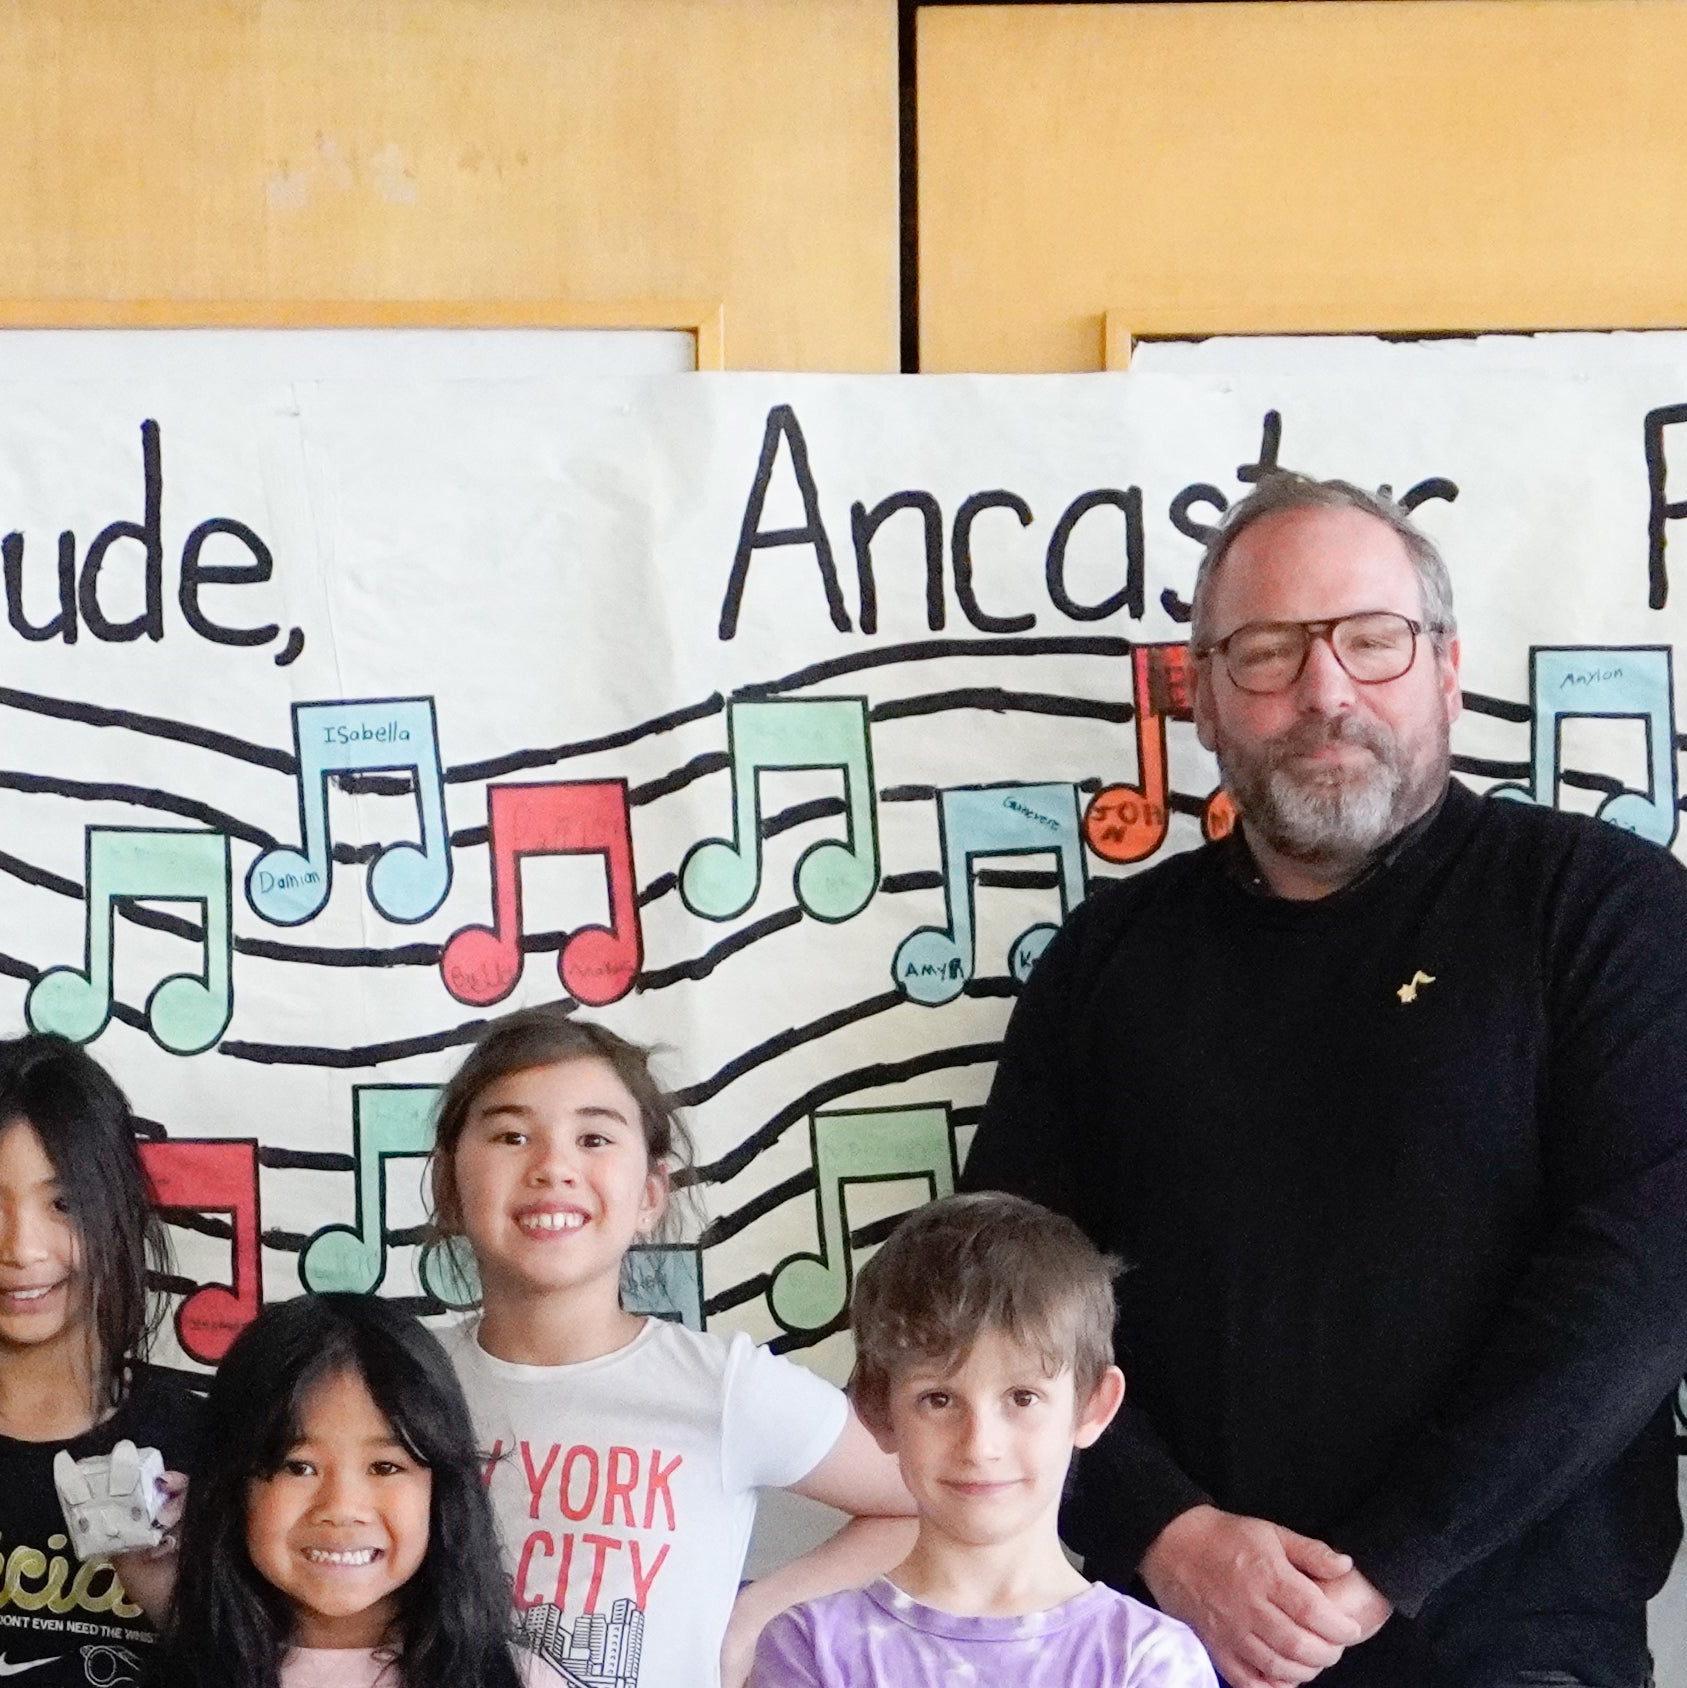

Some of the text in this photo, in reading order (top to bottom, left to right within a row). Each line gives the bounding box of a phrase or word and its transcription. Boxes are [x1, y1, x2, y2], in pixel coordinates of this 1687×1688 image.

[519, 1440, 684, 1531] YORK
[514, 1529, 672, 1615] CITY
[32, 1617, 64, 1632] EVEN
[66, 1620, 99, 1636] NEED
[100, 1625, 123, 1639] THE
